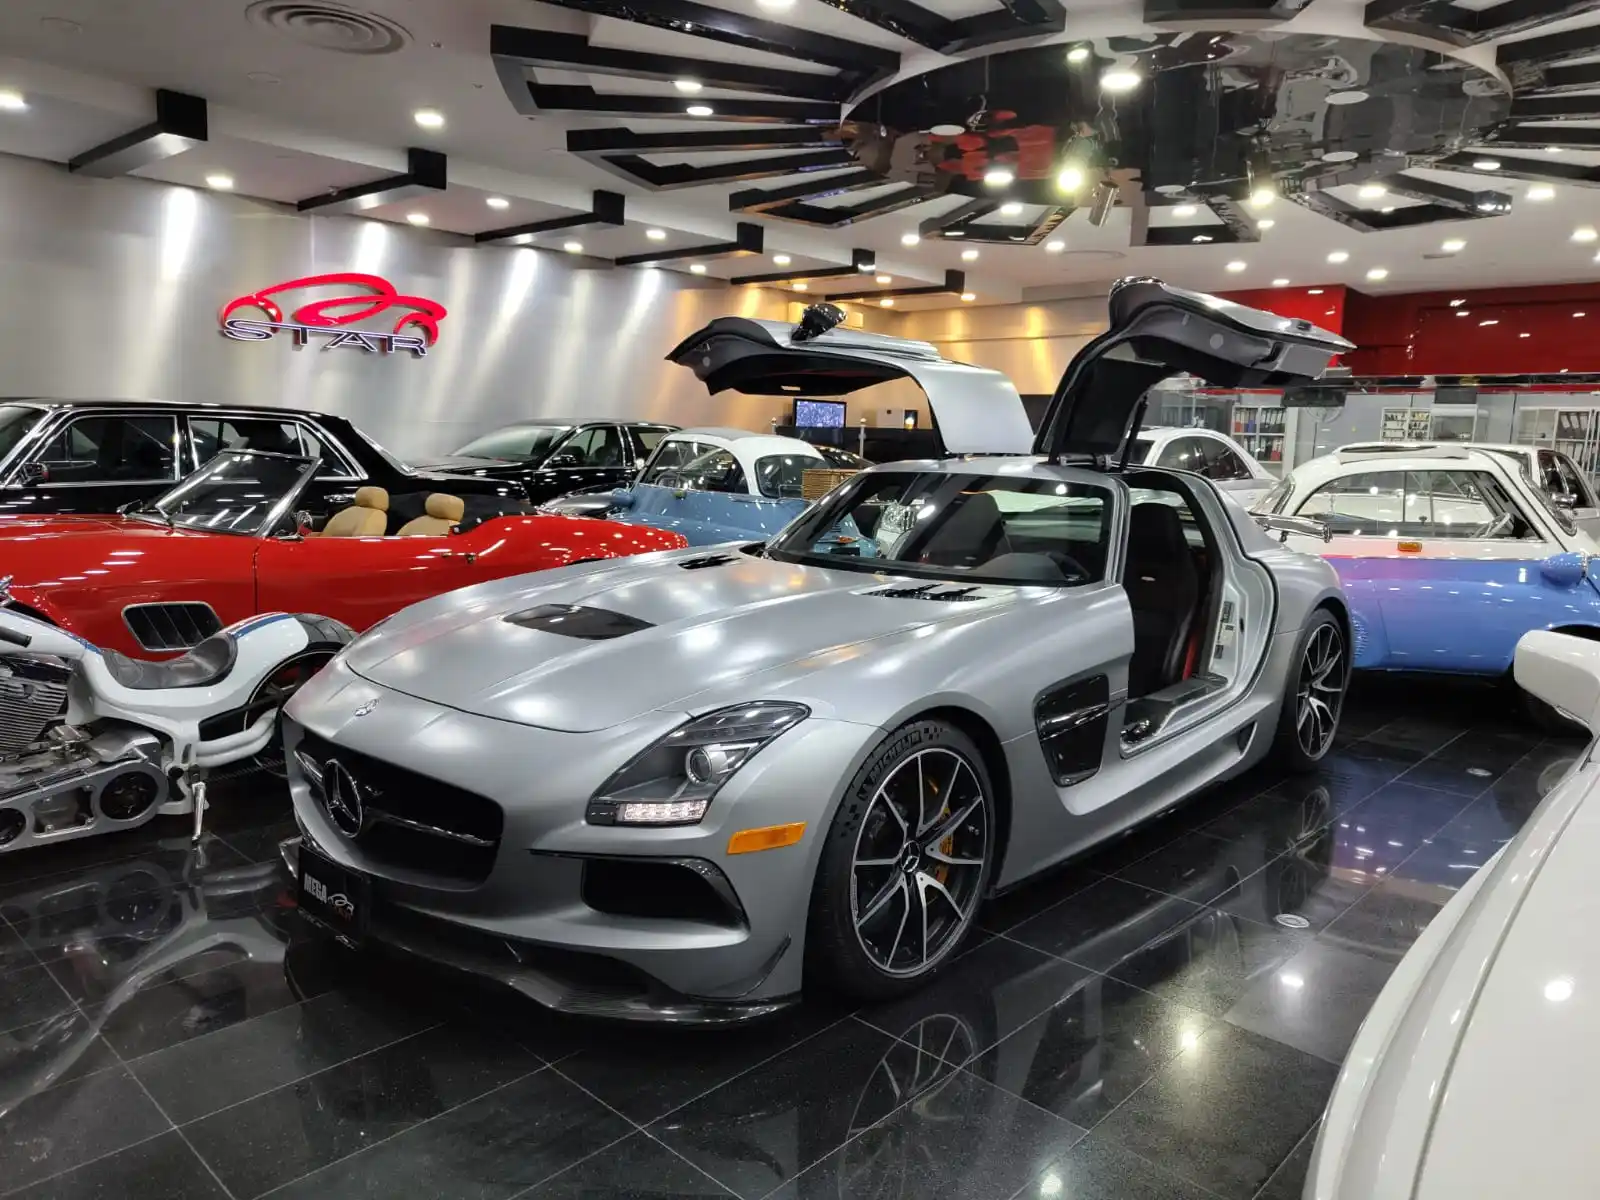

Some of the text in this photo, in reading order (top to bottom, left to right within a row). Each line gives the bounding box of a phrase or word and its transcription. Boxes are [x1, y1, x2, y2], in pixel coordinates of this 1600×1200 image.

[223, 319, 428, 356] STAR
[870, 730, 922, 783] MICHELIN
[304, 872, 327, 904] MEGA
